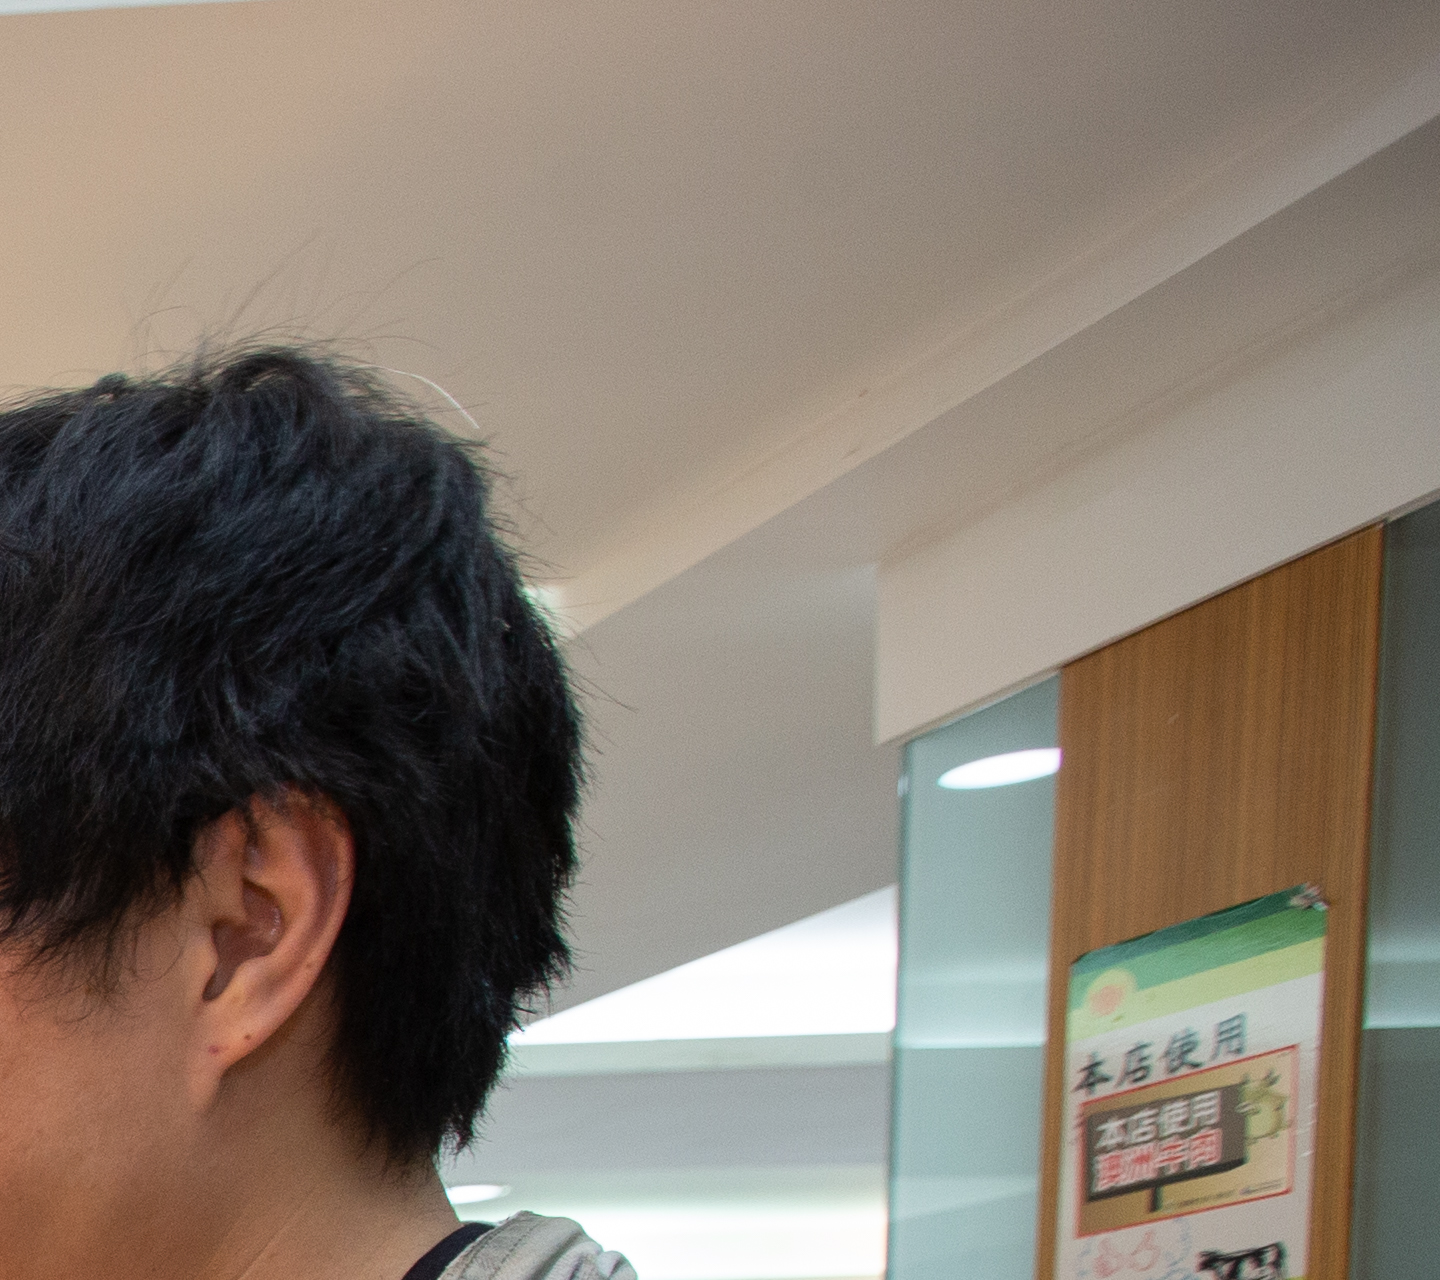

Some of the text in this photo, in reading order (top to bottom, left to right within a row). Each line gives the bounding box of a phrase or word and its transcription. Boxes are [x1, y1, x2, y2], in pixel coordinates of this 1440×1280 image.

[1072, 1012, 1249, 1095] 本店使用
[1095, 1091, 1222, 1149] 本店使用
[1094, 1128, 1223, 1191] 澳洲牛肉
